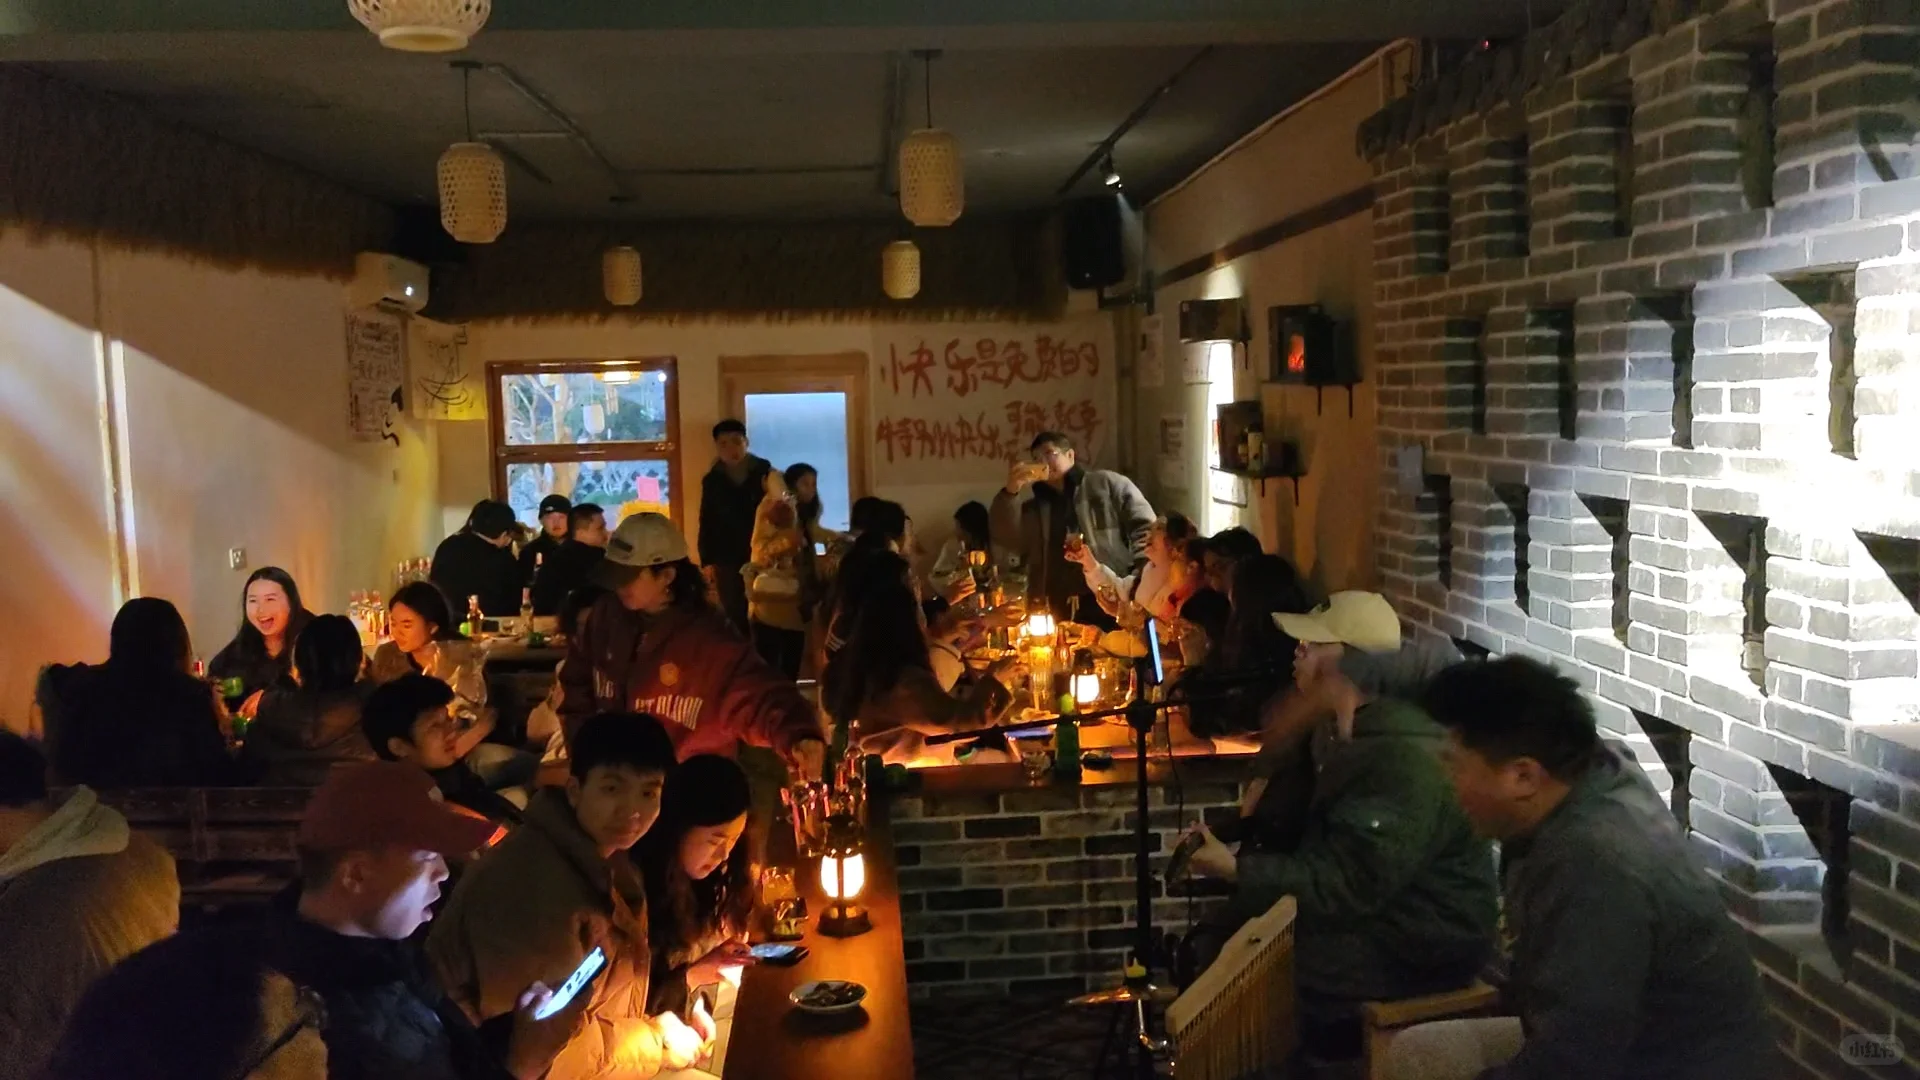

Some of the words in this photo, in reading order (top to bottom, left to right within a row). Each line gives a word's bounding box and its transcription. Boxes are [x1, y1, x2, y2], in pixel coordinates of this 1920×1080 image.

[880, 334, 1100, 397] 快乐是免费的
